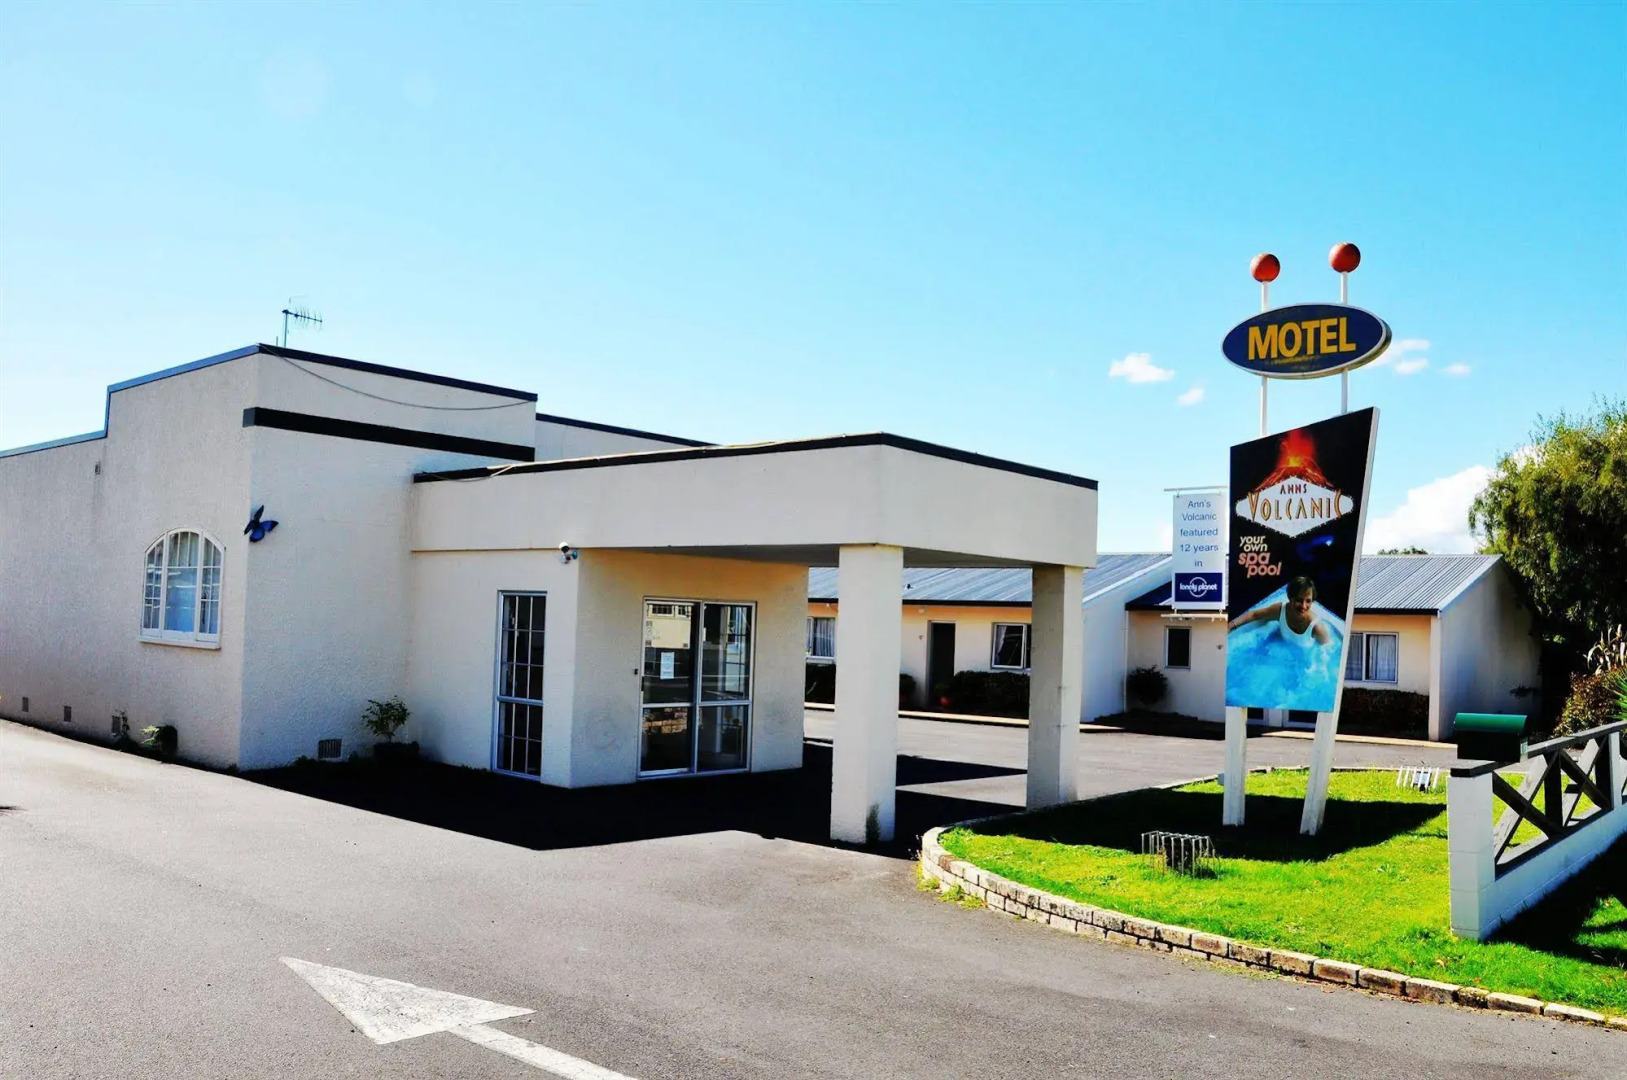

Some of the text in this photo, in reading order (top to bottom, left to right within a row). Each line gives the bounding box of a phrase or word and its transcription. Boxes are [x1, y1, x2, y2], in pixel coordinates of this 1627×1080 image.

[1248, 317, 1357, 360] MOTEL
[1280, 484, 1307, 494] ANNS
[1187, 500, 1211, 508] Ann's
[1247, 489, 1342, 522] VOLCANIC
[1181, 513, 1217, 521] Volcanic
[1180, 528, 1218, 537] featured
[1240, 535, 1266, 547] your
[1180, 544, 1219, 553] 12 years
[1243, 543, 1268, 552] own
[1238, 552, 1271, 567] spa
[1247, 562, 1282, 578] pool
[1179, 583, 1218, 592] lonely planet
